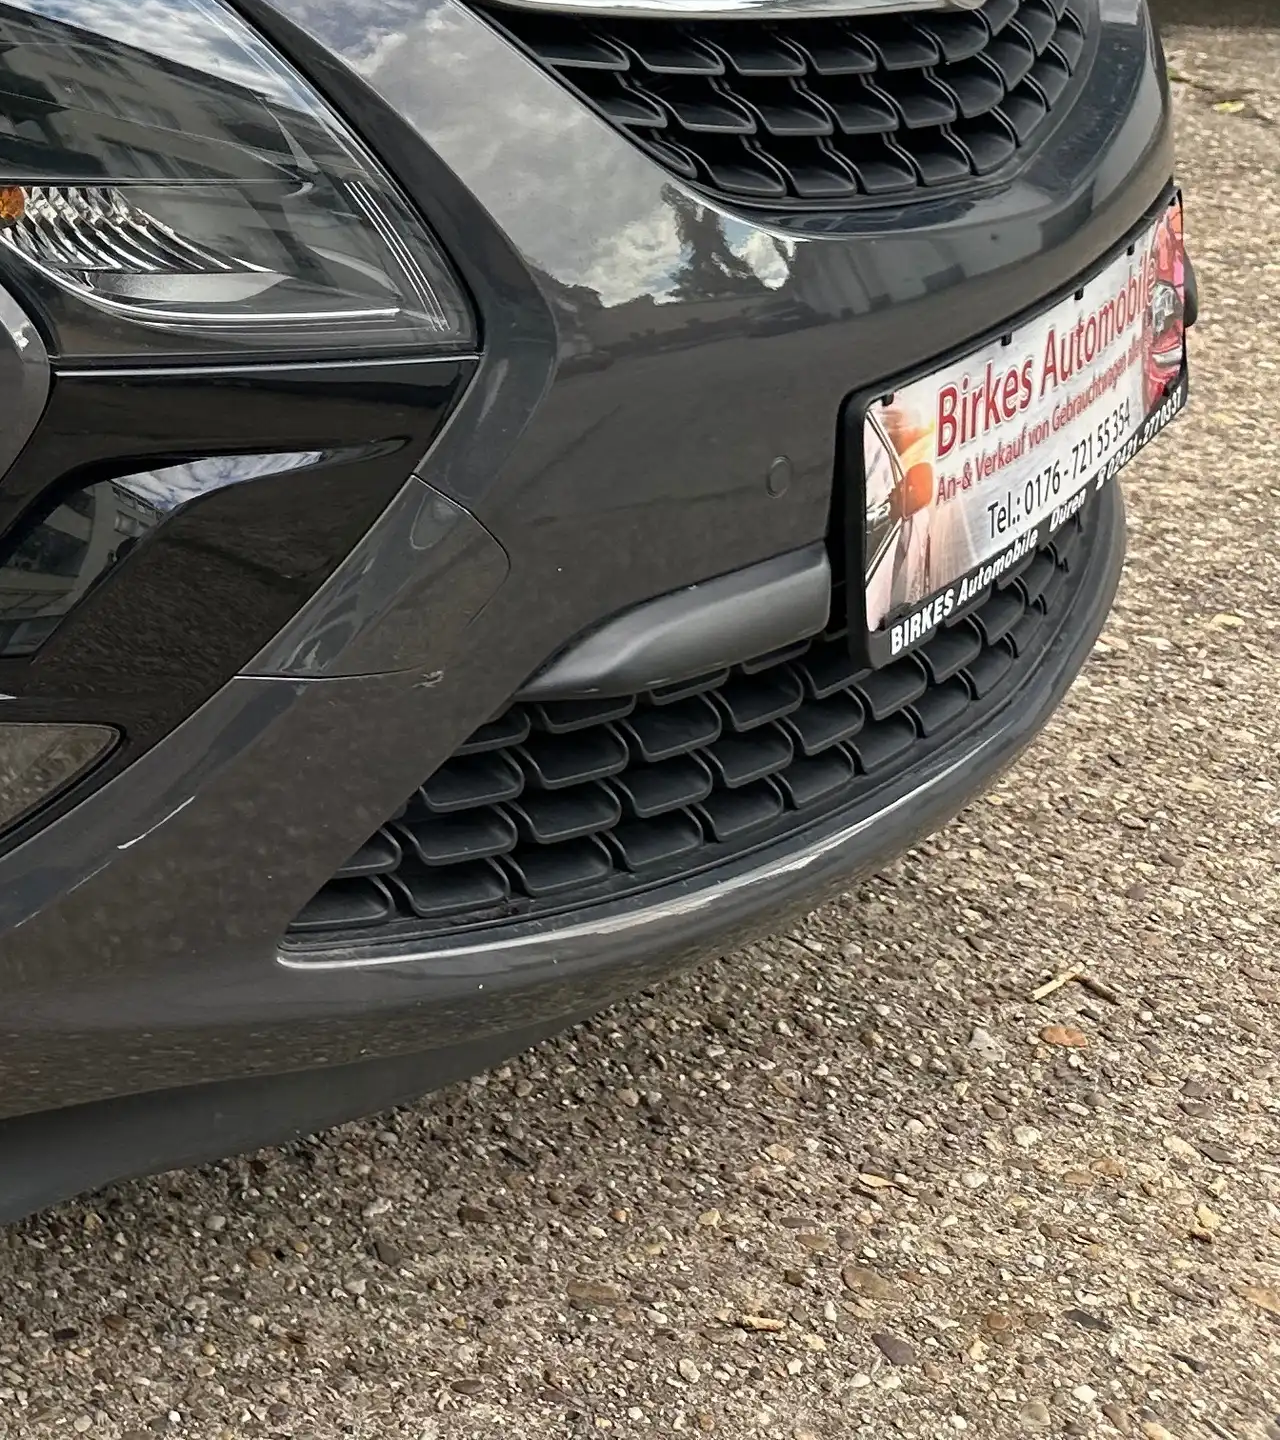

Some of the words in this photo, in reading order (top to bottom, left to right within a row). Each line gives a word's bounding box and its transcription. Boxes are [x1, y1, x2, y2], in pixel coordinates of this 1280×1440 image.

[937, 360, 1032, 457] Birkes
[1040, 251, 1156, 396] Automobile
[974, 425, 1027, 483] Verkauf
[1028, 416, 1049, 448] von
[988, 491, 1021, 539] Tel.:
[1024, 459, 1061, 515] 0176
[1072, 436, 1092, 480] 721
[1097, 417, 1110, 459] 55
[1112, 396, 1131, 443] 354
[890, 588, 955, 656] BIRKES
[957, 529, 1039, 606] Automobile
[1049, 488, 1086, 533] Düren
